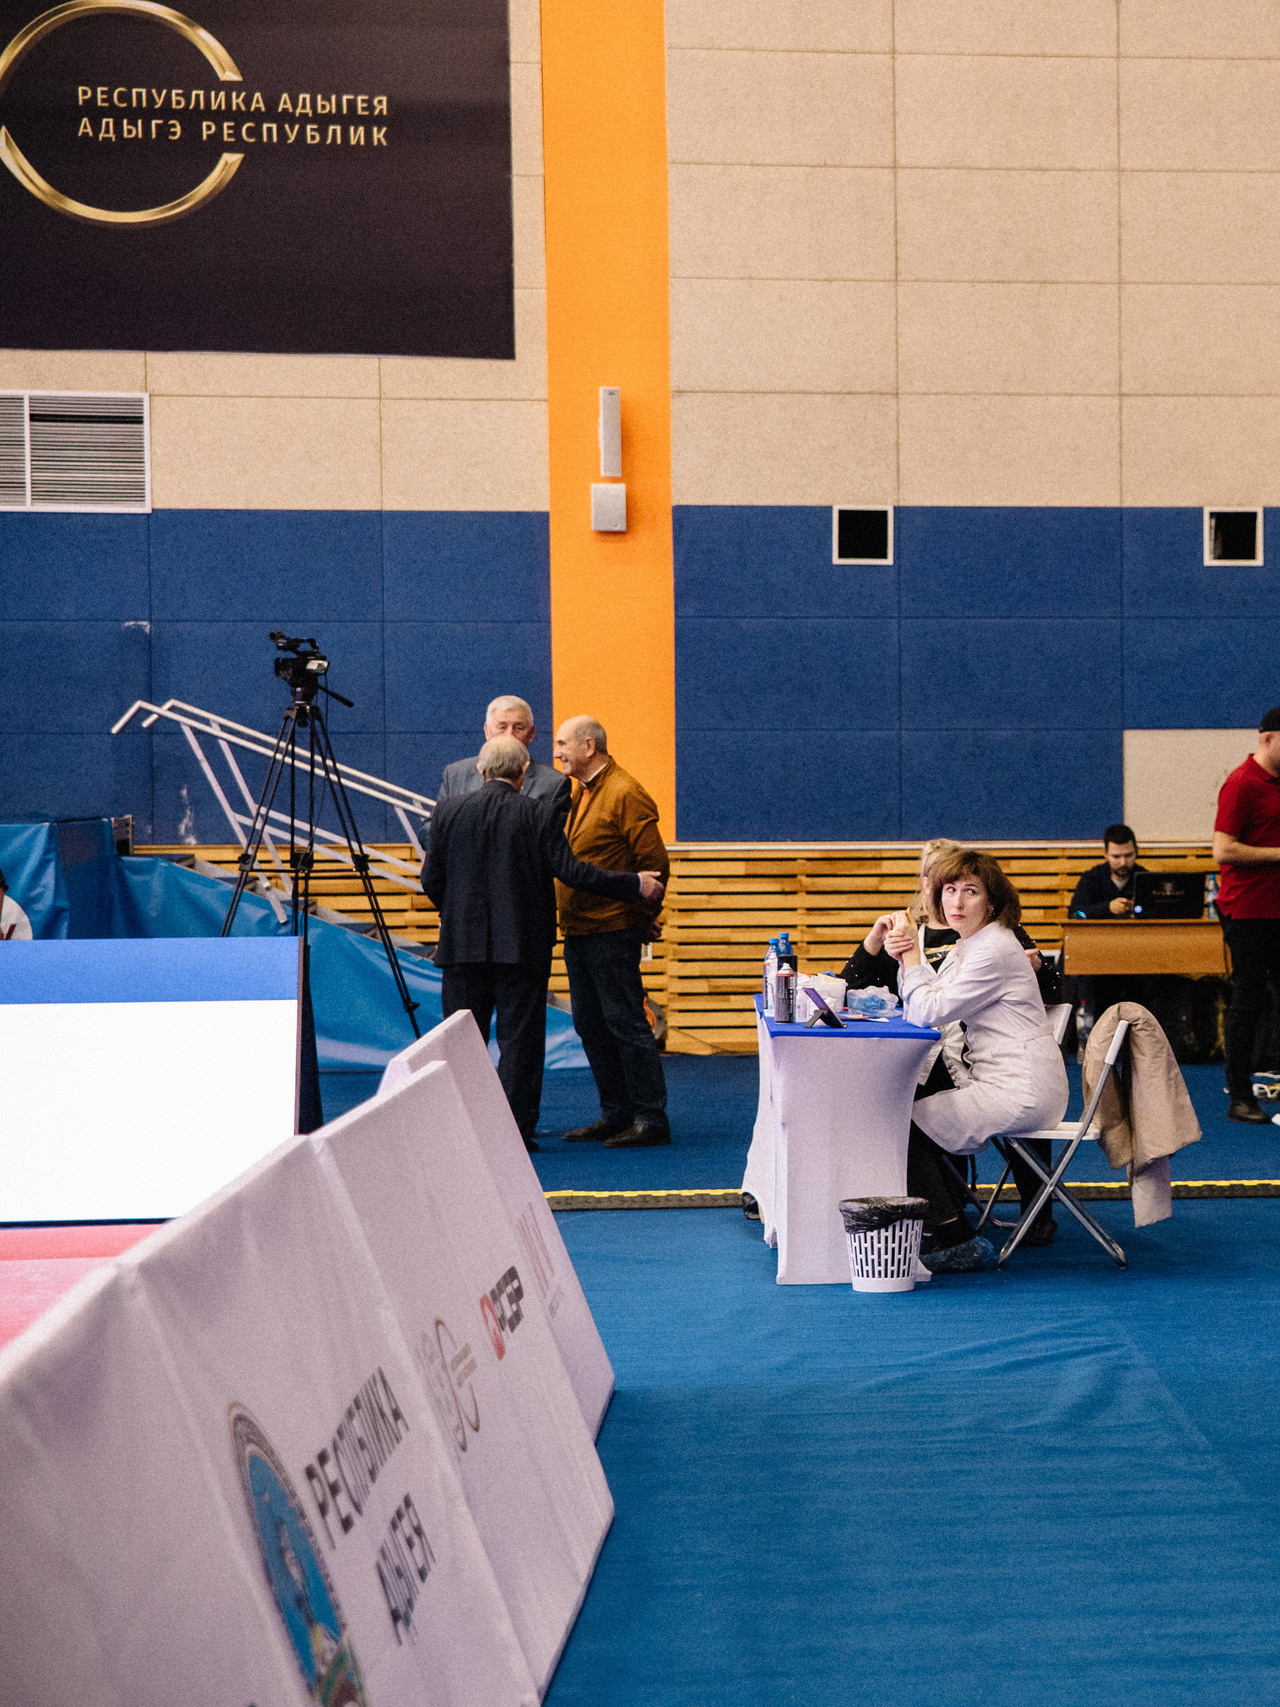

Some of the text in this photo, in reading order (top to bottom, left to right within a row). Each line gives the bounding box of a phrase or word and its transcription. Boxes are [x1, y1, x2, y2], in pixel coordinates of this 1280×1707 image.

[78, 86, 388, 118] РЕСПУБЛИКА АДЫГЕЯ
[78, 117, 388, 146] АДЫГЭ РЕСПУБЛИК
